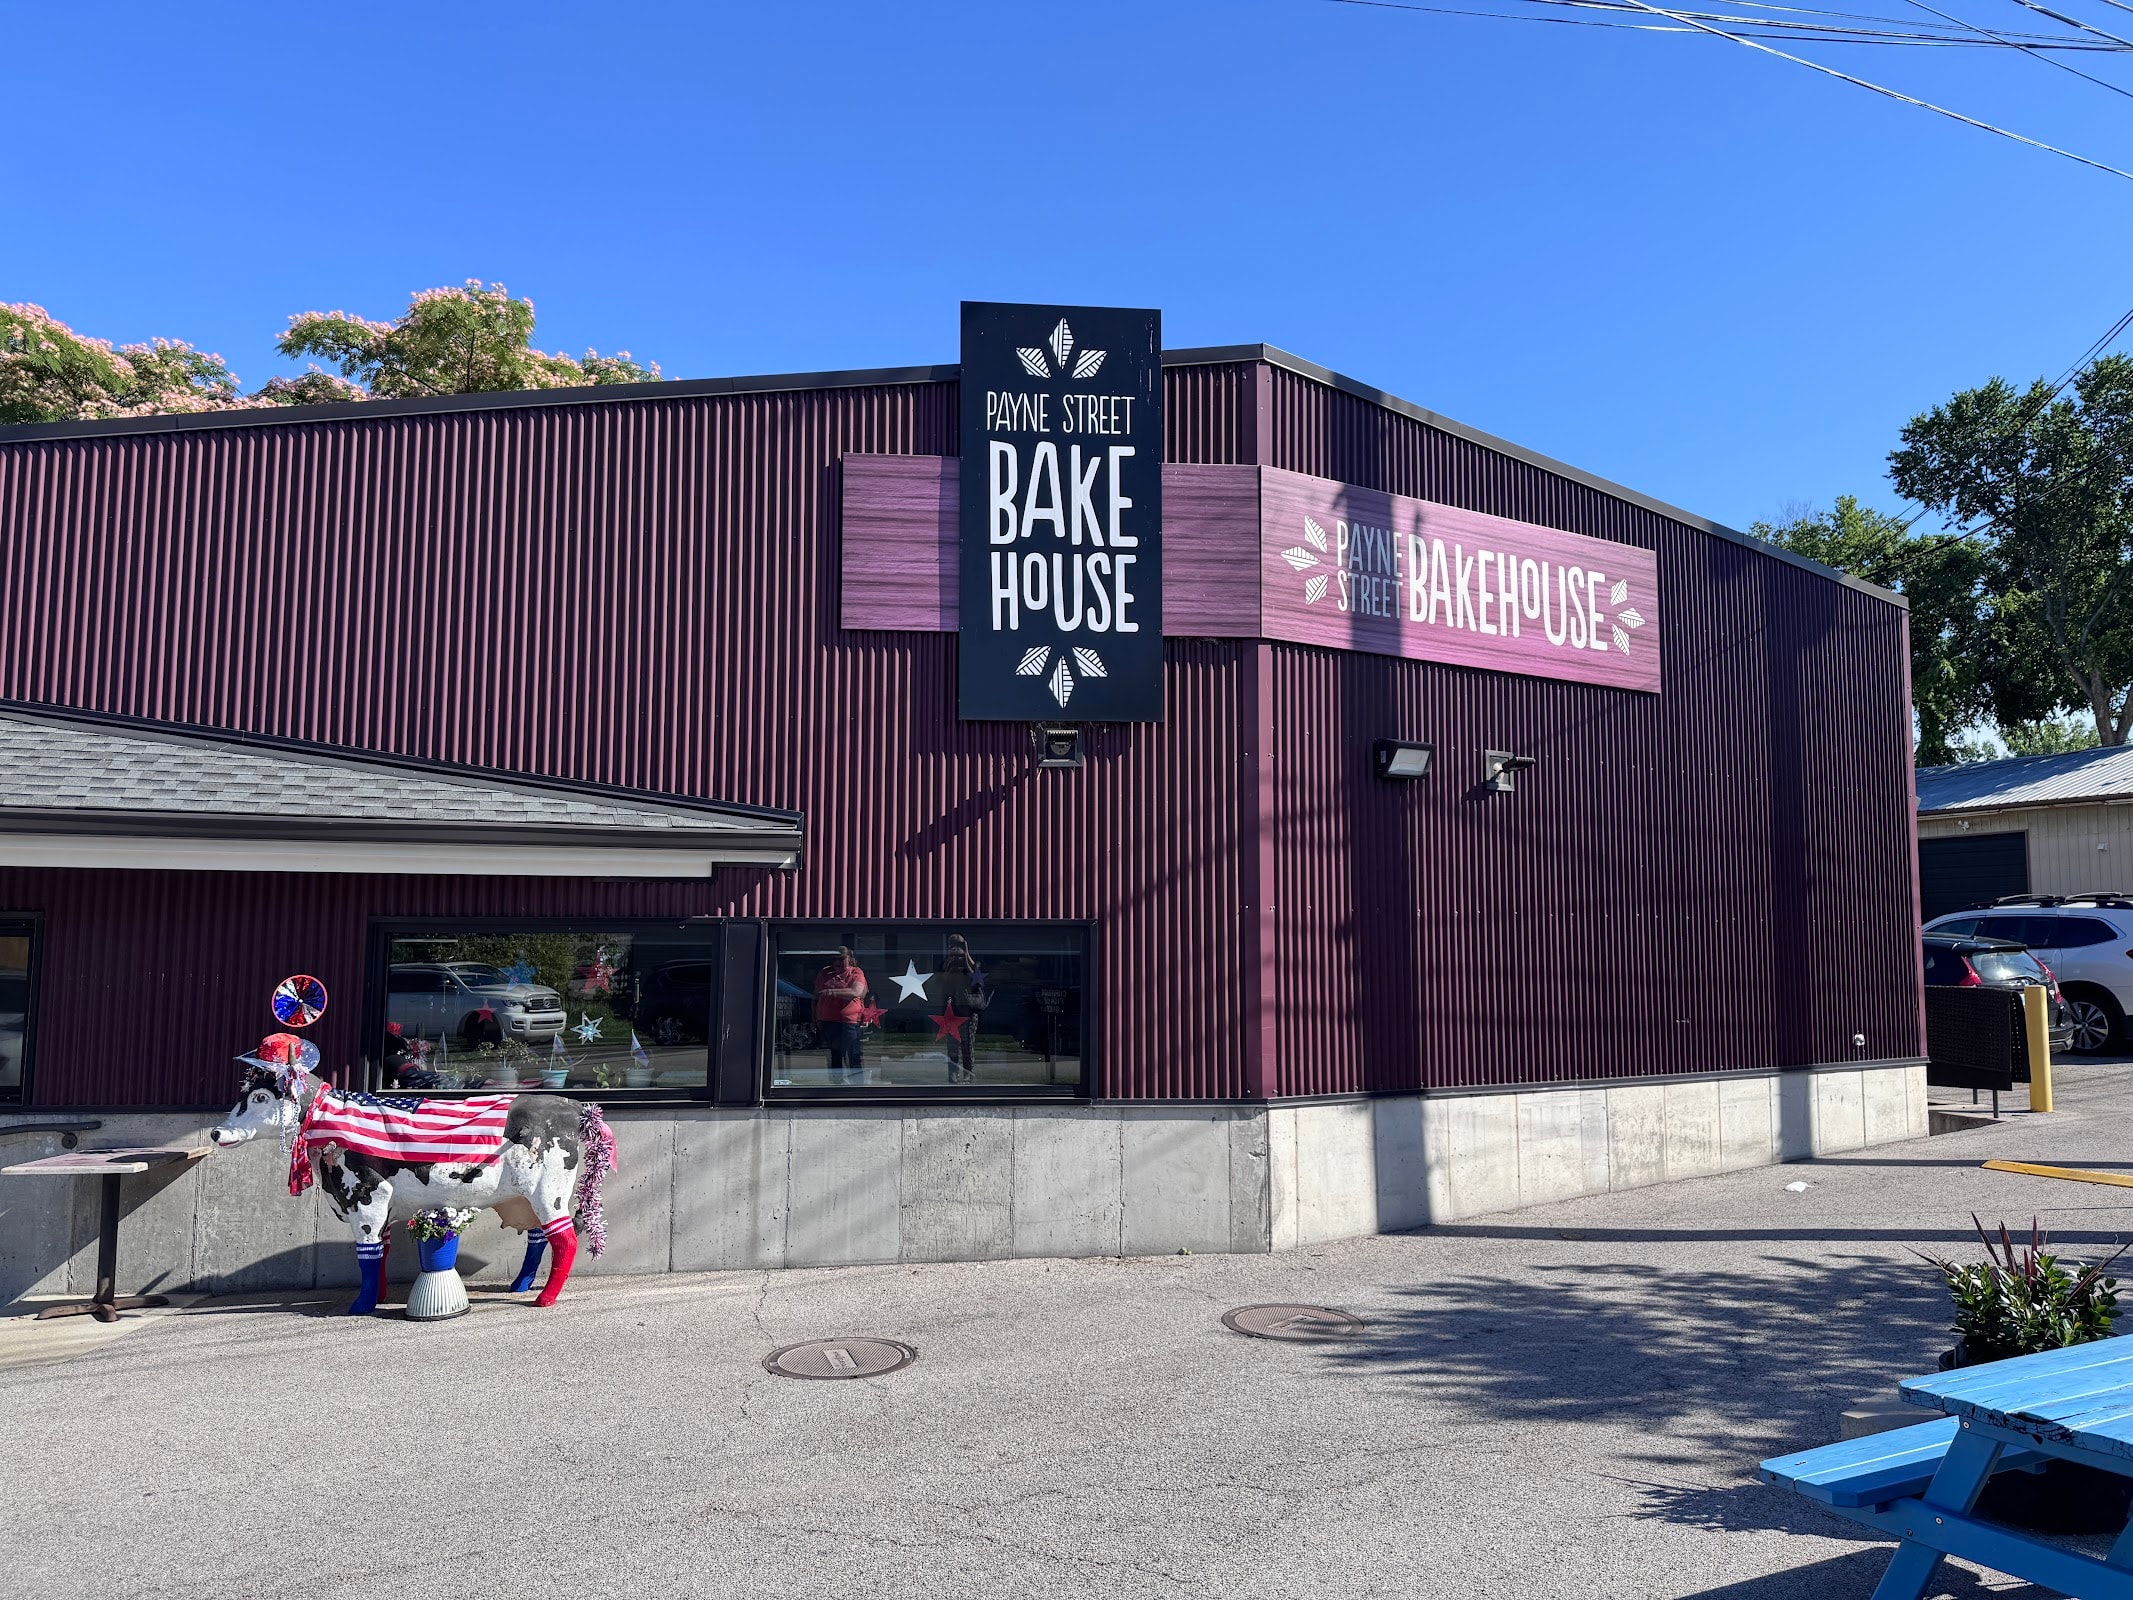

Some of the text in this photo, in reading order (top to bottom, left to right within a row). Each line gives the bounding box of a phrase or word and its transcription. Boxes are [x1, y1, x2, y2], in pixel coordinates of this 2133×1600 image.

[986, 390, 1136, 435] PAYNE STREET
[989, 439, 1139, 548] BAKE
[1336, 519, 1404, 578] PAYNE
[1336, 569, 1404, 619] STREET
